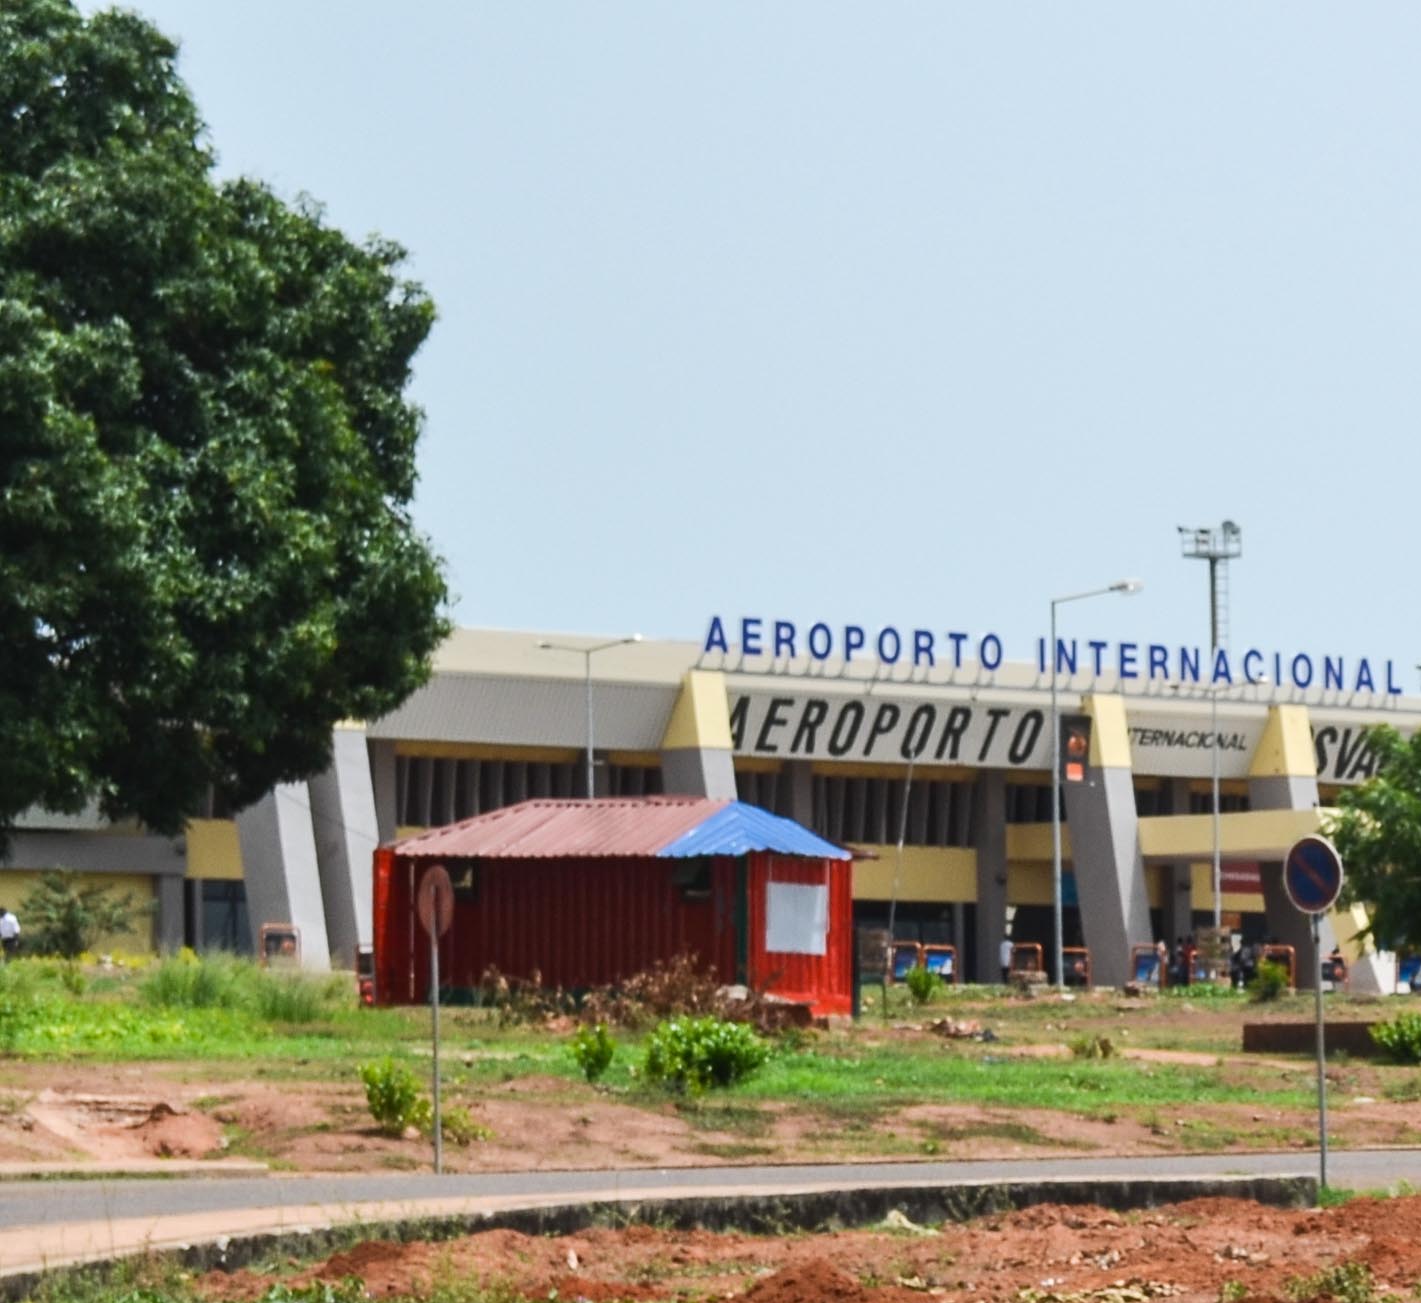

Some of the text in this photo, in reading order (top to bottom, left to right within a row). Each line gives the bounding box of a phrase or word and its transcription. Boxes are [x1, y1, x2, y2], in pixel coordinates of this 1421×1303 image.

[704, 616, 1003, 670] AEROPORTO
[1039, 638, 1402, 695] INTERNACIONAL
[728, 695, 1045, 765] AEROPORTO
[1127, 727, 1248, 751] TERNACIONAL
